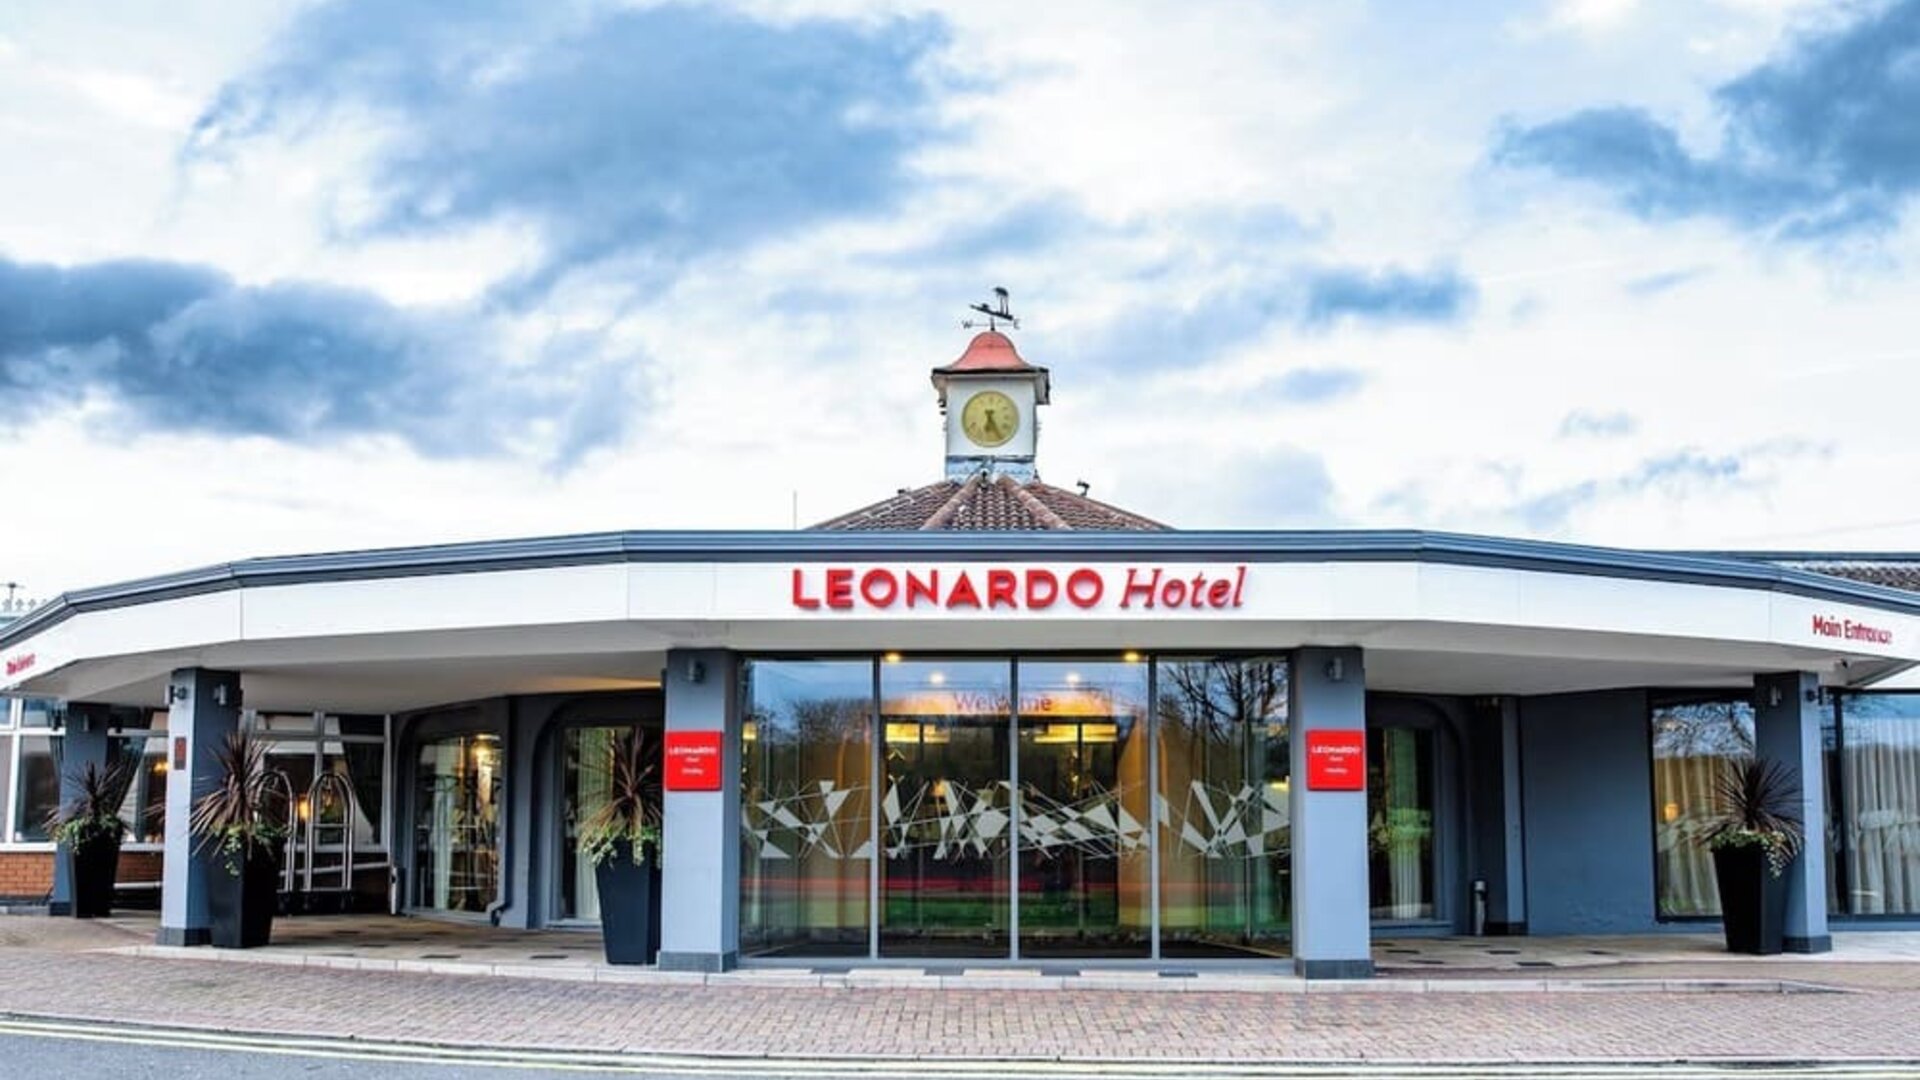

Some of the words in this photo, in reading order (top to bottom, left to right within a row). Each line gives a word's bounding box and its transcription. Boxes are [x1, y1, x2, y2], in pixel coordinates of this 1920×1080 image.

[792, 567, 1105, 609] LEONARDO
[1119, 566, 1248, 608] Hotel
[1812, 614, 1842, 638] Main
